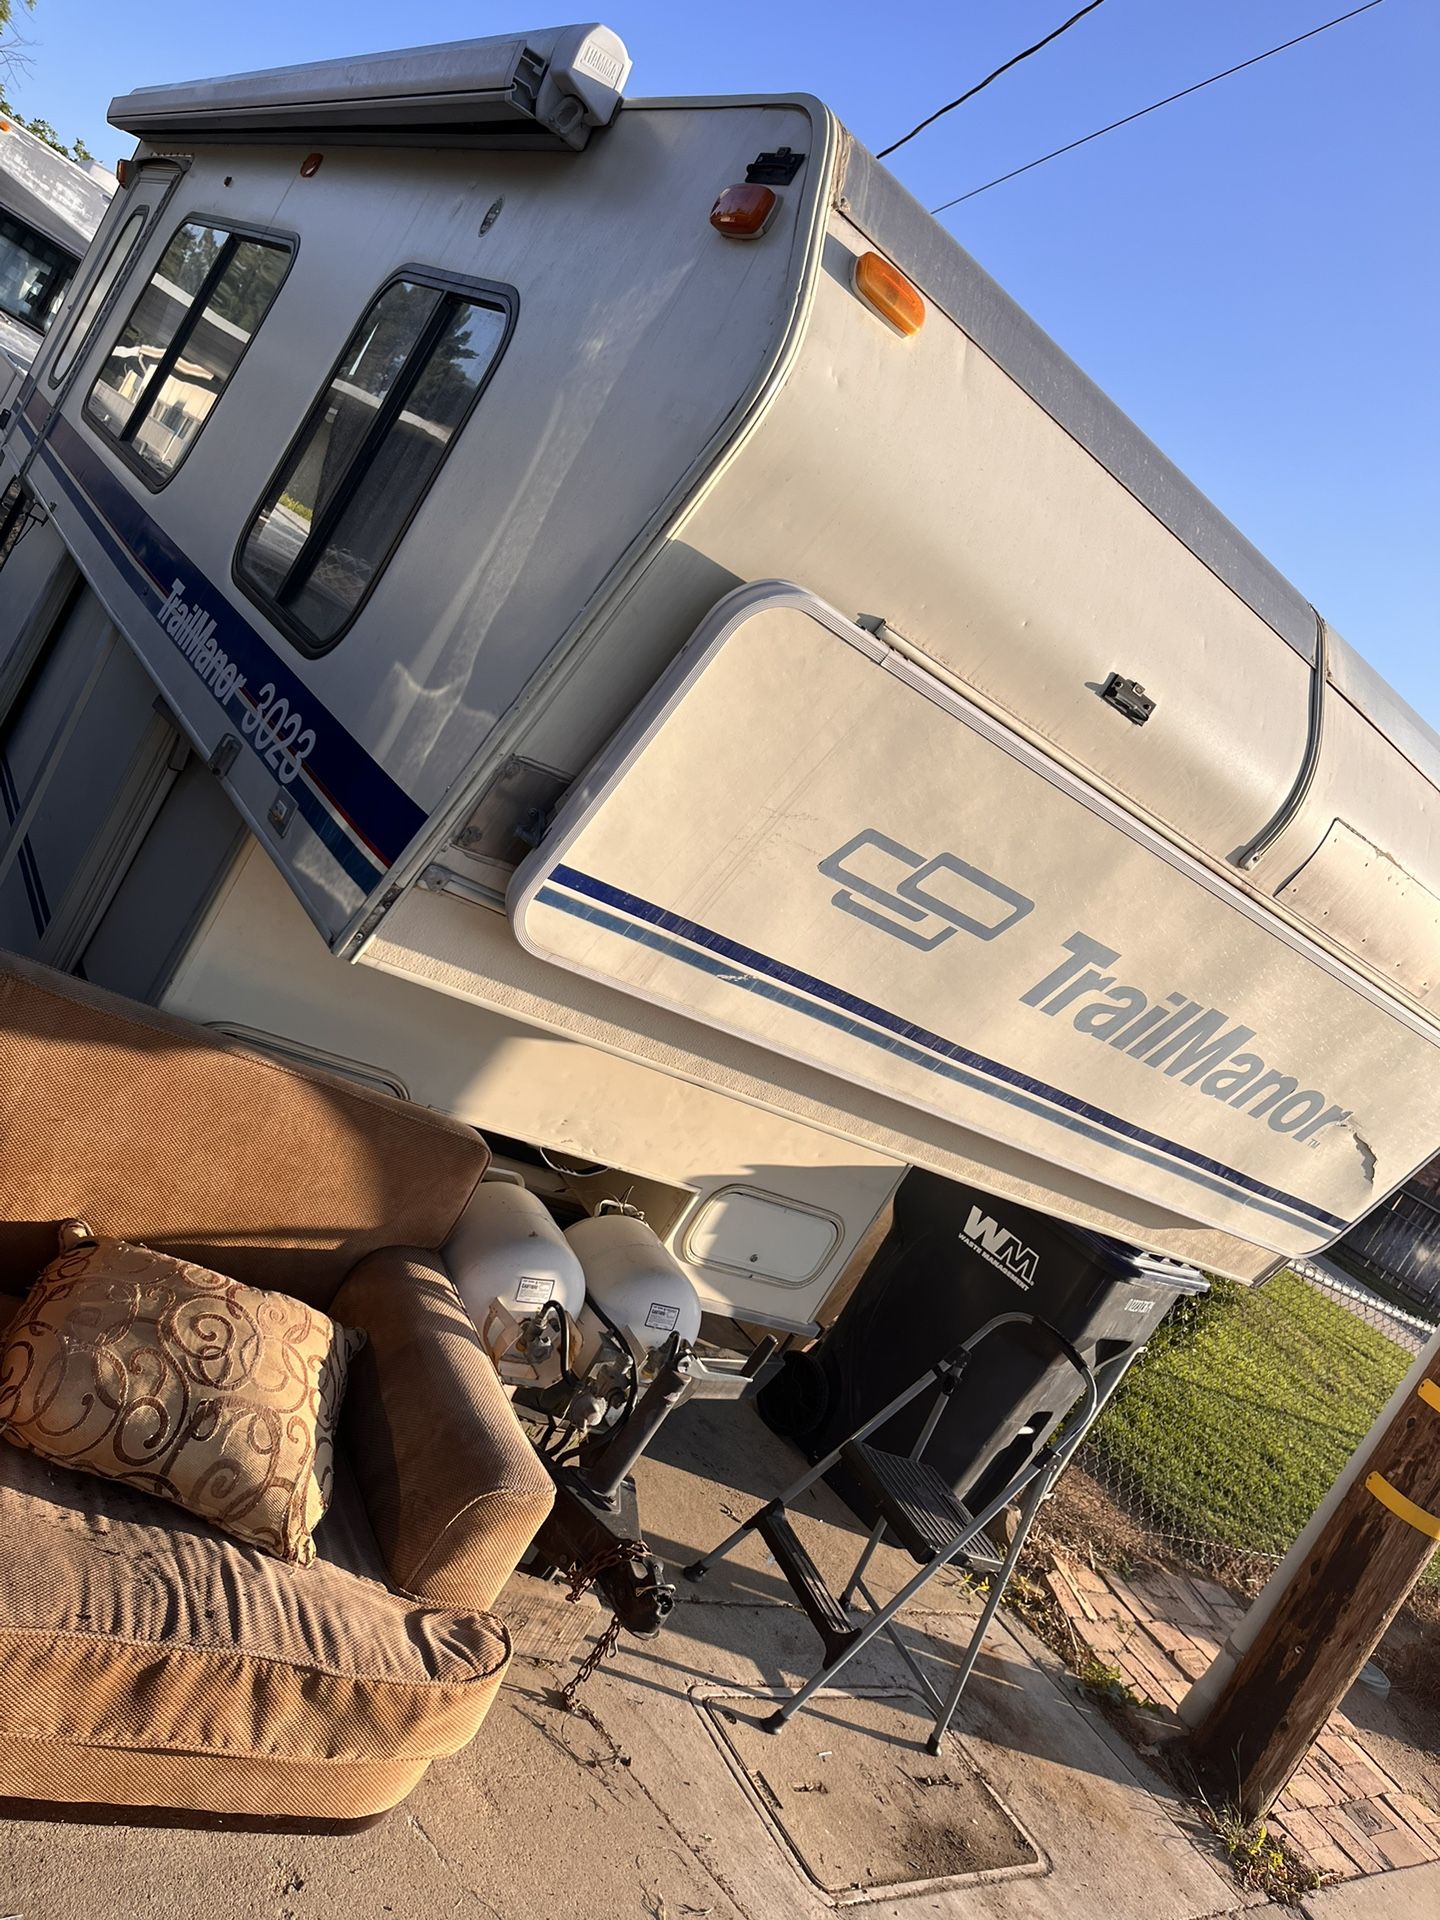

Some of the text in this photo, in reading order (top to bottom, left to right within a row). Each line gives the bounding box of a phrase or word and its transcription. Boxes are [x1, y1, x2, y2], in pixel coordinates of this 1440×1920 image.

[157, 578, 316, 784] TrailManor 3023
[1019, 931, 1353, 1142] TrailManor
[958, 1233, 1029, 1291] WASTE MANAGEMENT
[963, 1205, 1039, 1283] WM
